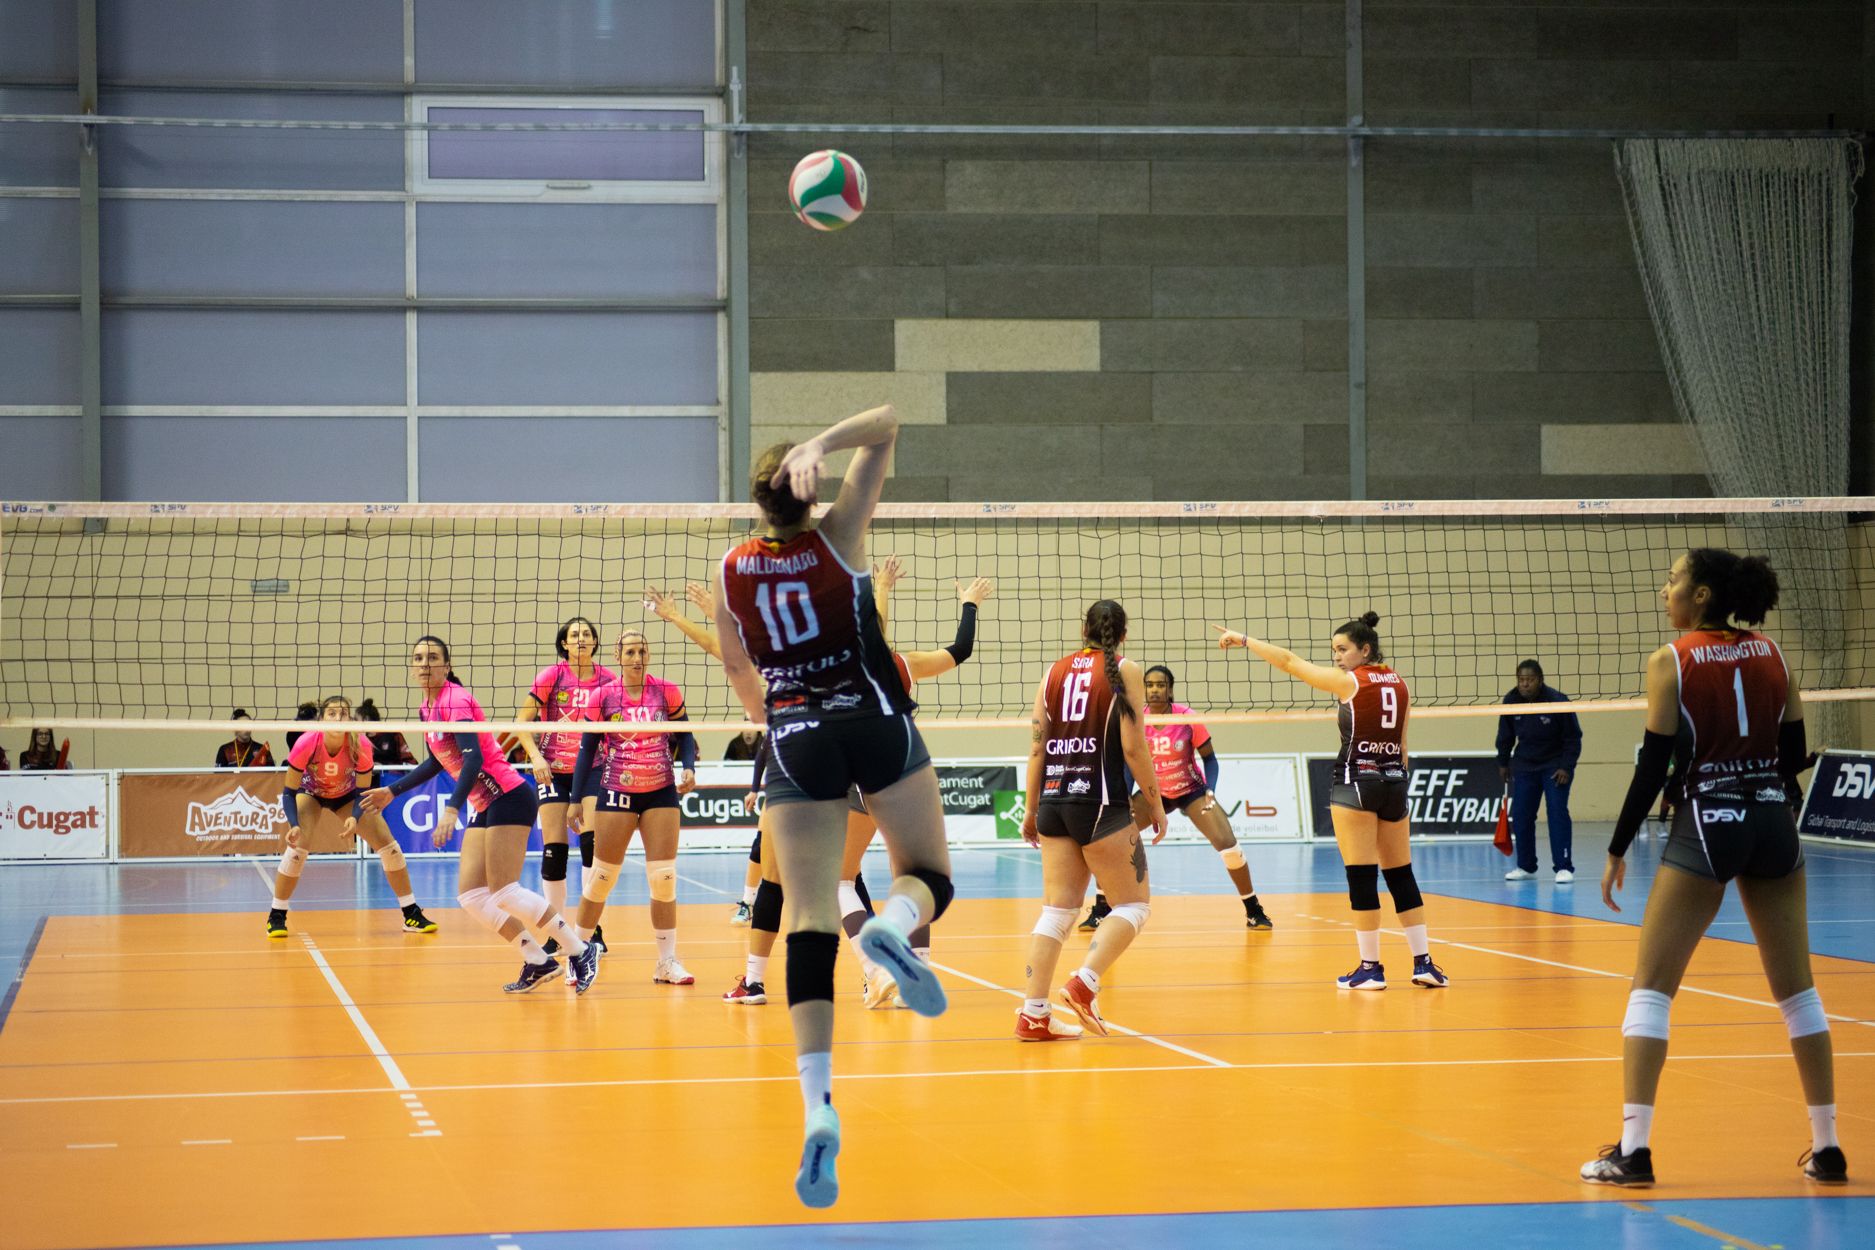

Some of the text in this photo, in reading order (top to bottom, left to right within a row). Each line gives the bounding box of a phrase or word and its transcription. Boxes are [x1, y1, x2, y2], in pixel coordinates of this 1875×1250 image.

[755, 581, 820, 651] 10
[1690, 640, 1772, 664] WASHINGTON
[1061, 671, 1092, 722] 16
[1381, 687, 1398, 729] 9
[1733, 667, 1749, 737] 1
[1046, 737, 1097, 755] GRIFOLS
[1151, 736, 1171, 755] 12
[324, 762, 338, 776] 9
[1832, 763, 1875, 799] DSV
[538, 783, 558, 800] 21
[938, 776, 984, 789] ament
[1407, 769, 1468, 796] EFF
[606, 790, 631, 809] 10
[17, 805, 99, 835] Cugat
[189, 804, 269, 833] AVENTURA
[1702, 809, 1746, 823] DSV
